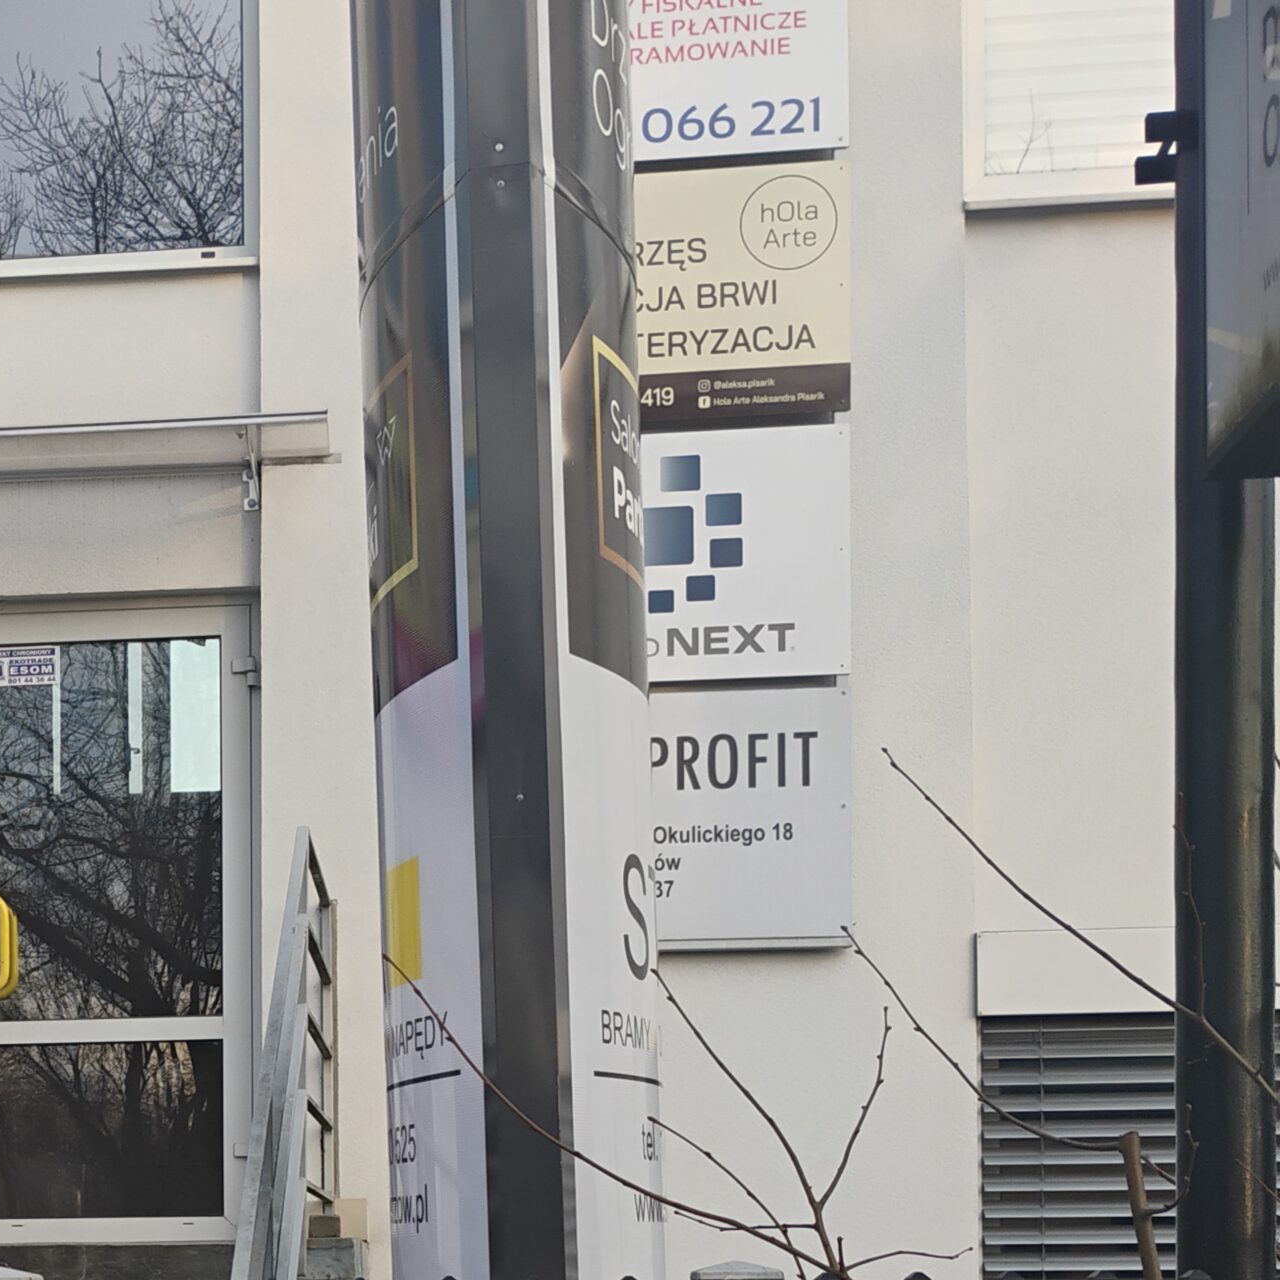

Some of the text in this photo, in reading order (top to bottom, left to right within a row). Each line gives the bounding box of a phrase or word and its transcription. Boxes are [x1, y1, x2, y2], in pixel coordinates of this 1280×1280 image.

[671, 10, 807, 38] PŁATNICZE
[630, 37, 791, 66] RAMOWANIE
[641, 96, 820, 144] 066 221
[763, 228, 817, 249] Arte
[696, 279, 777, 309] BRWI
[637, 323, 816, 358] ERYZACJA
[10, 665, 53, 675] ESOM
[650, 731, 818, 791] PROFIT
[653, 822, 794, 847] Okulickiego 18
[600, 1009, 650, 1052] BRAMY
